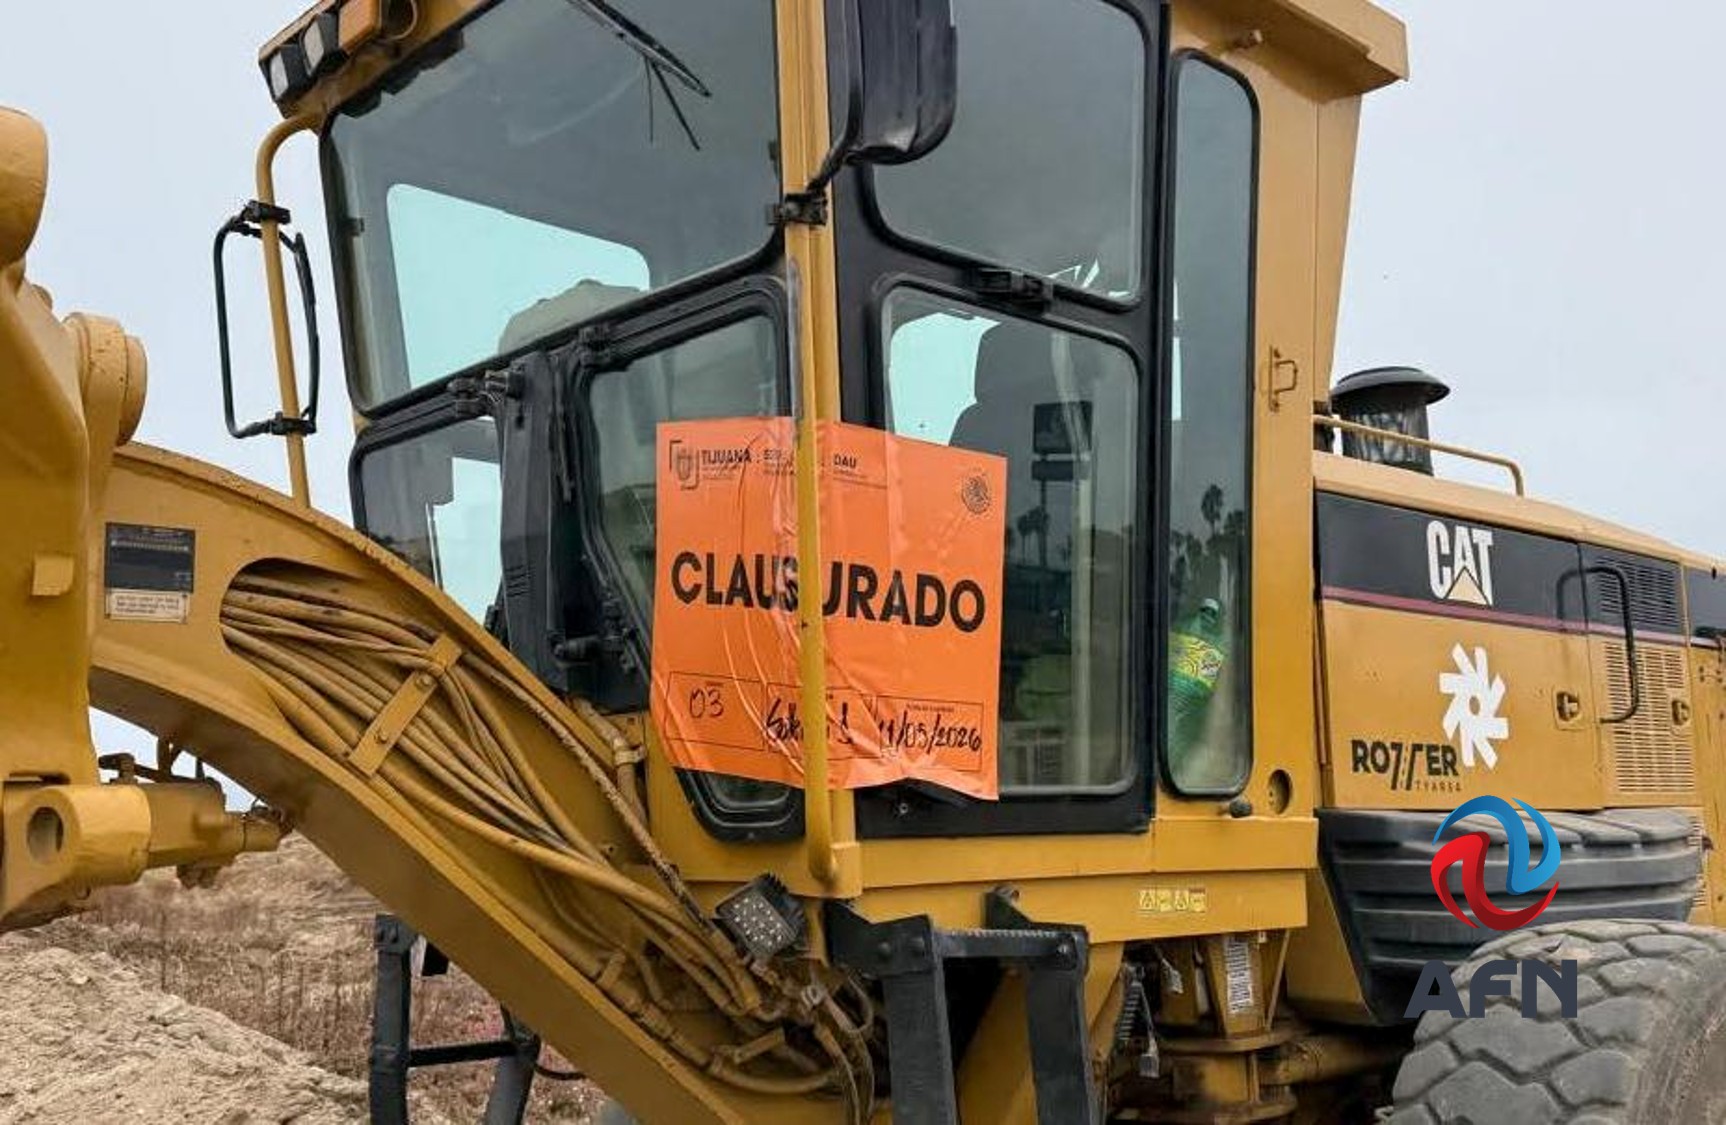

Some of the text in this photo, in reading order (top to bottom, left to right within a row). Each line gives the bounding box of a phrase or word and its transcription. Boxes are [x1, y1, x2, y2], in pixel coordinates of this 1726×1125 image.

[701, 448, 752, 465] TIJUANA
[1426, 519, 1495, 606] CAT
[671, 551, 986, 633] CLAUSURADO
[689, 688, 724, 719] 03
[1351, 739, 1459, 791] ROTTER
